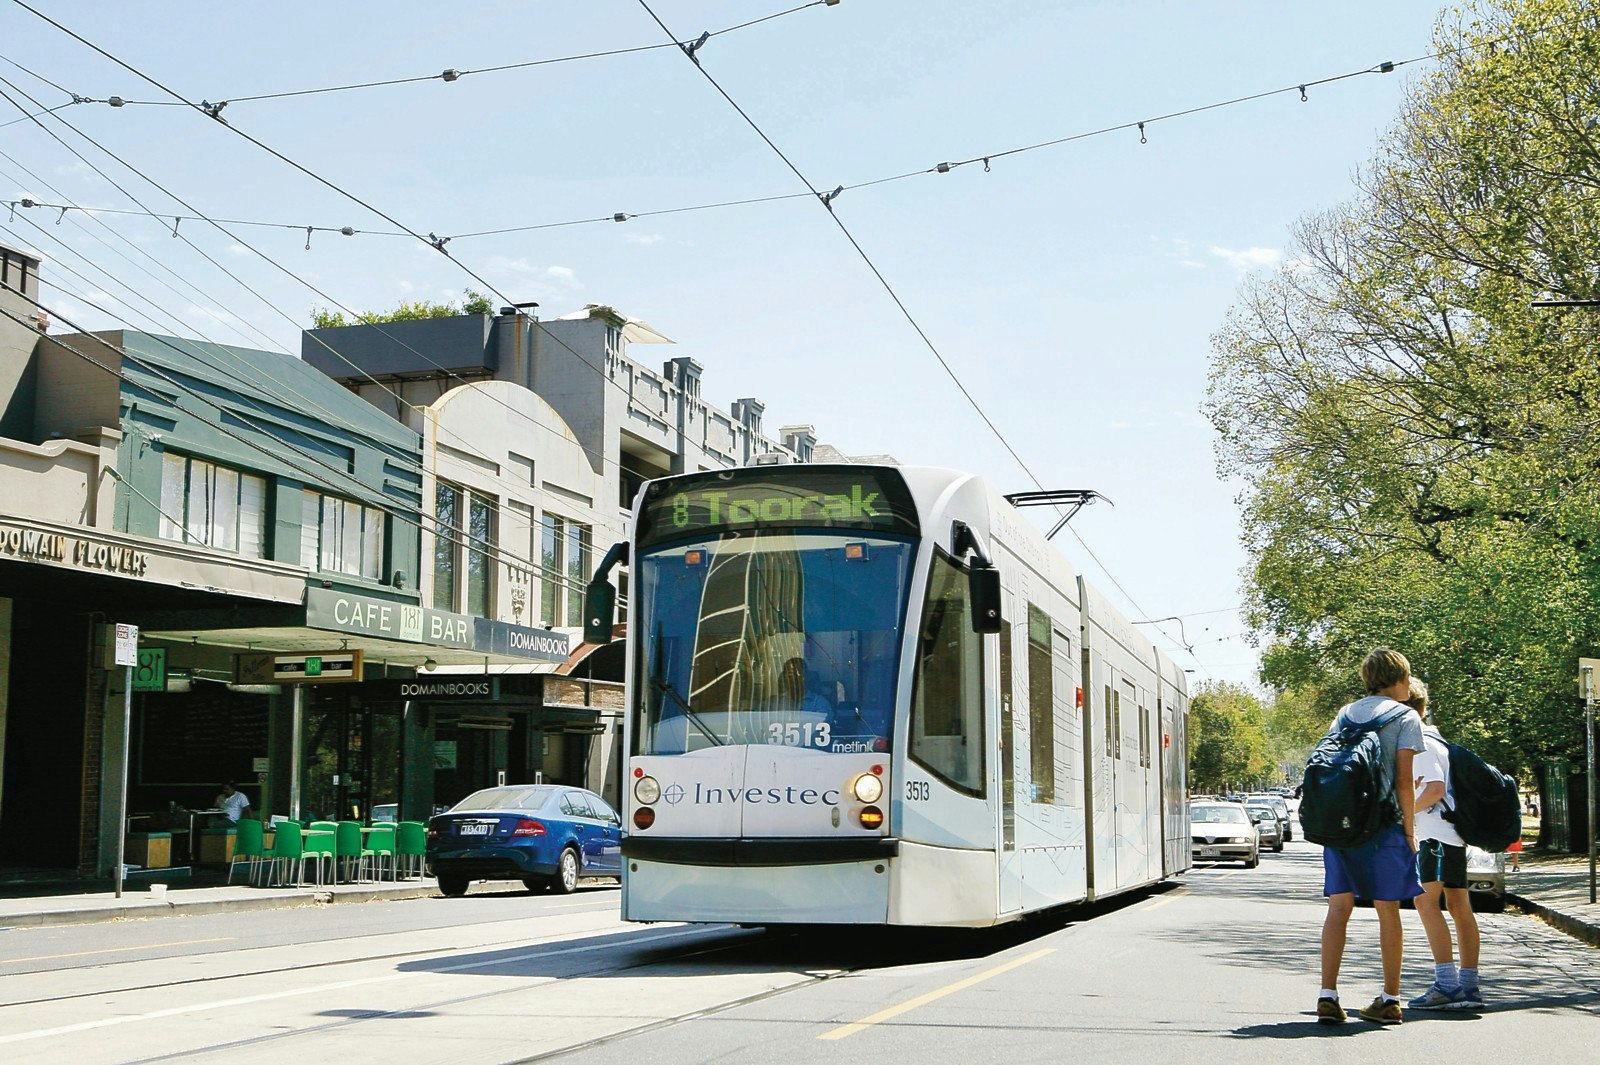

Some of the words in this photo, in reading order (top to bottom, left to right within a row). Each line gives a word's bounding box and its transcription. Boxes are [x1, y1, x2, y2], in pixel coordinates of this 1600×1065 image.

[673, 492, 689, 528] 8
[701, 484, 880, 525] Toorak
[0, 529, 66, 559] DOMAIN
[77, 540, 149, 573] FLOWERS
[334, 598, 392, 632] CAFE
[431, 615, 468, 644] BAR
[510, 631, 567, 656] DOMAINBOOKS
[283, 663, 297, 671] cafe
[330, 662, 342, 670] bar
[401, 682, 489, 696] DOMAINBOOKS
[768, 722, 831, 747] 3513
[832, 740, 874, 753] metlink
[694, 782, 840, 806] Investec
[906, 781, 930, 801] 3513
